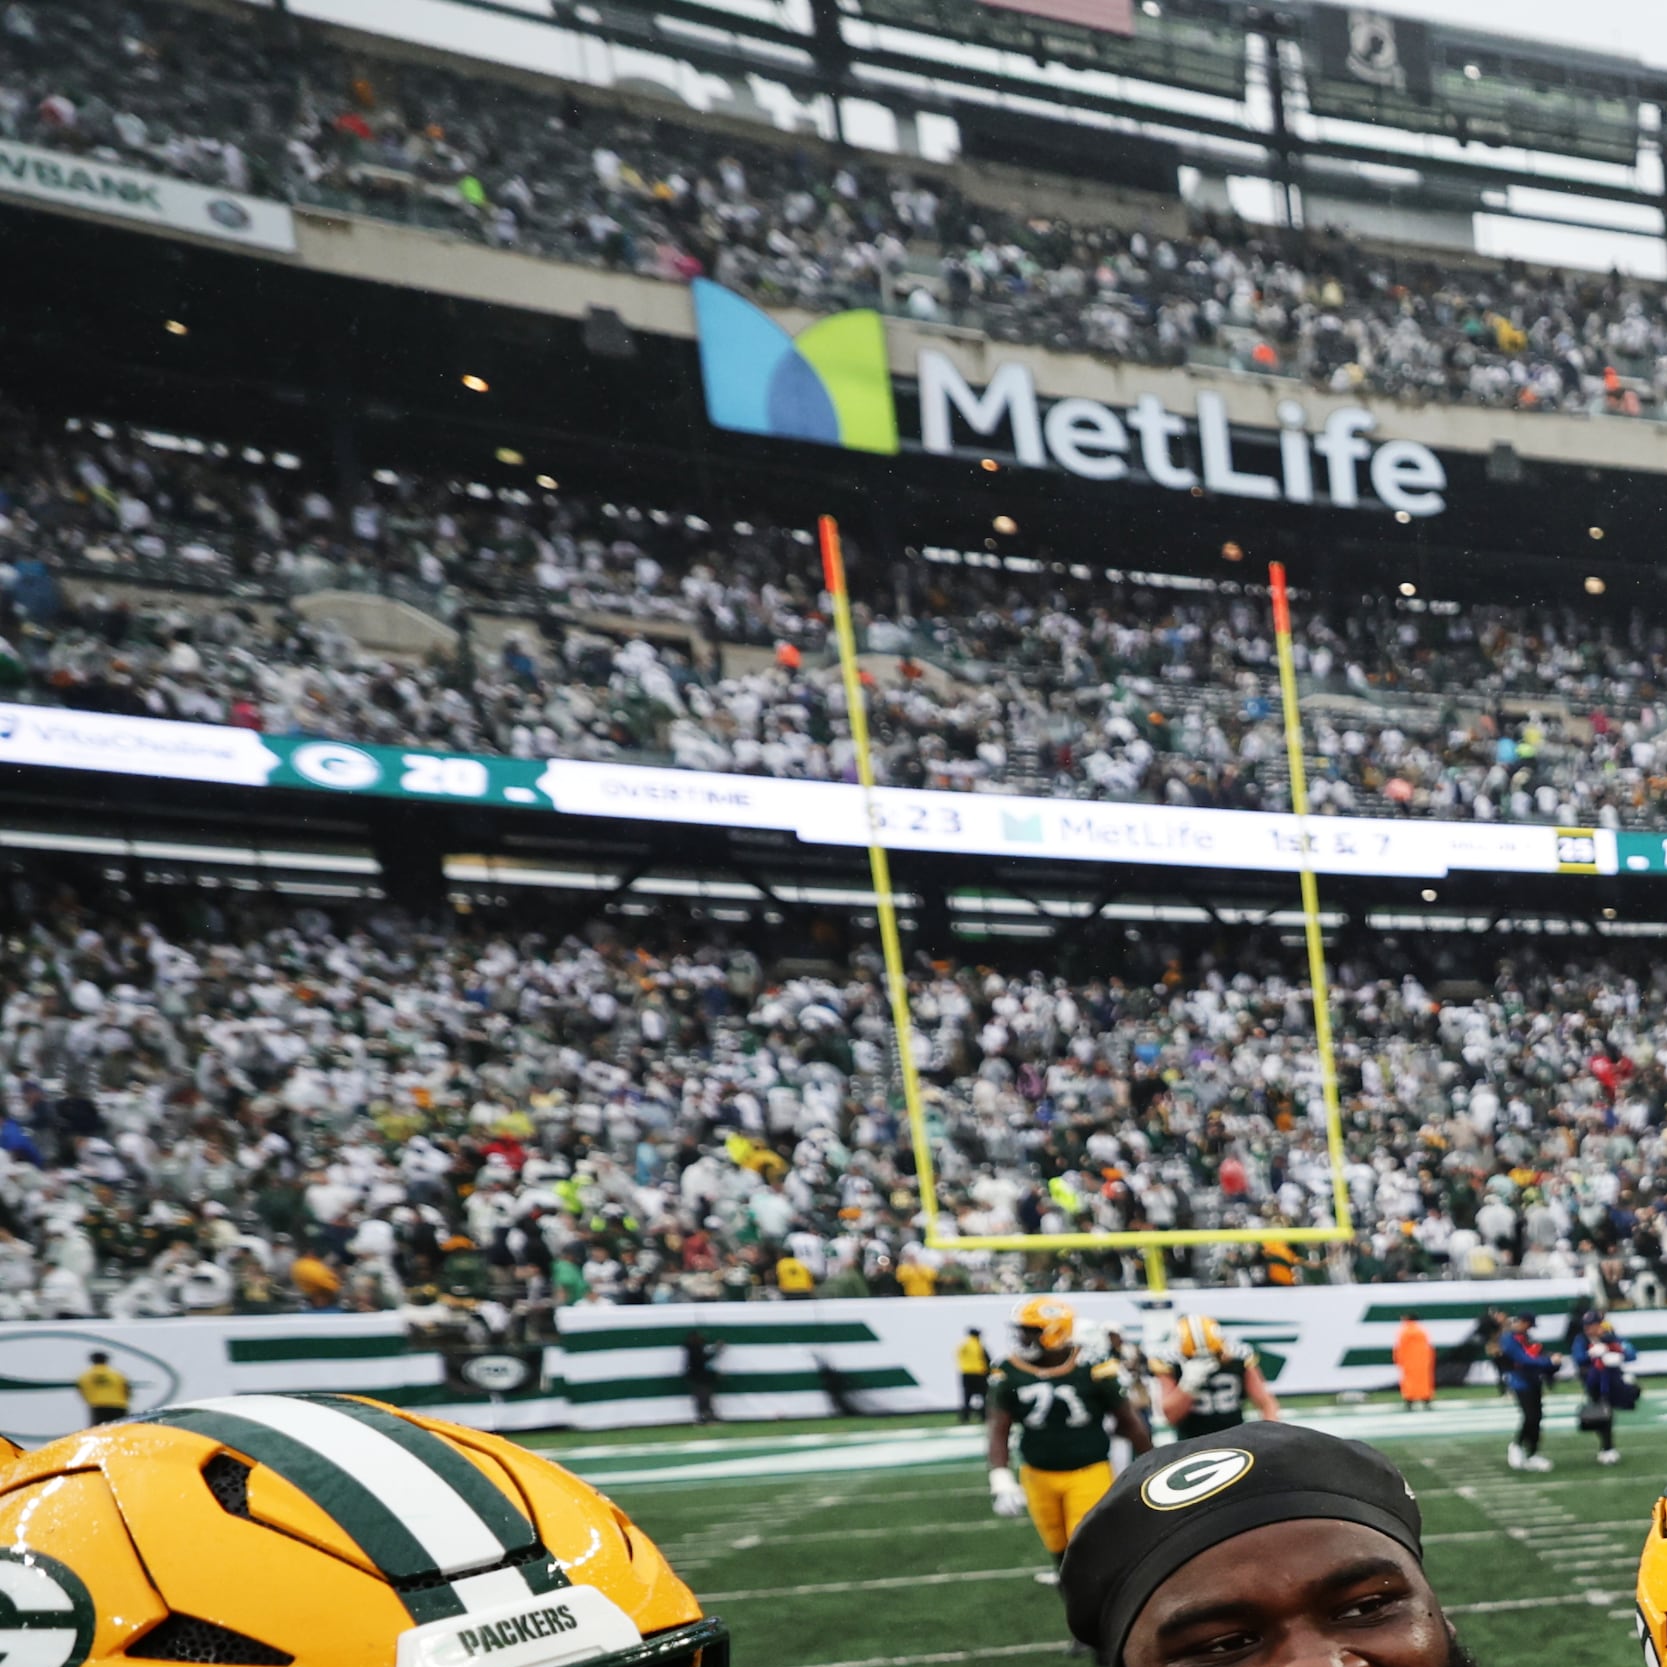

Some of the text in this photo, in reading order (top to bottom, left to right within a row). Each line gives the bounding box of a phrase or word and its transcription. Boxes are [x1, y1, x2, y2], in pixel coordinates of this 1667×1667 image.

[916, 349, 1447, 517] MetLife
[603, 780, 753, 807] OVERTIME
[1059, 816, 1217, 850] MetLife
[1016, 1381, 1093, 1430] 71
[1146, 1449, 1252, 1507] G
[457, 1604, 578, 1658] PACKERS
